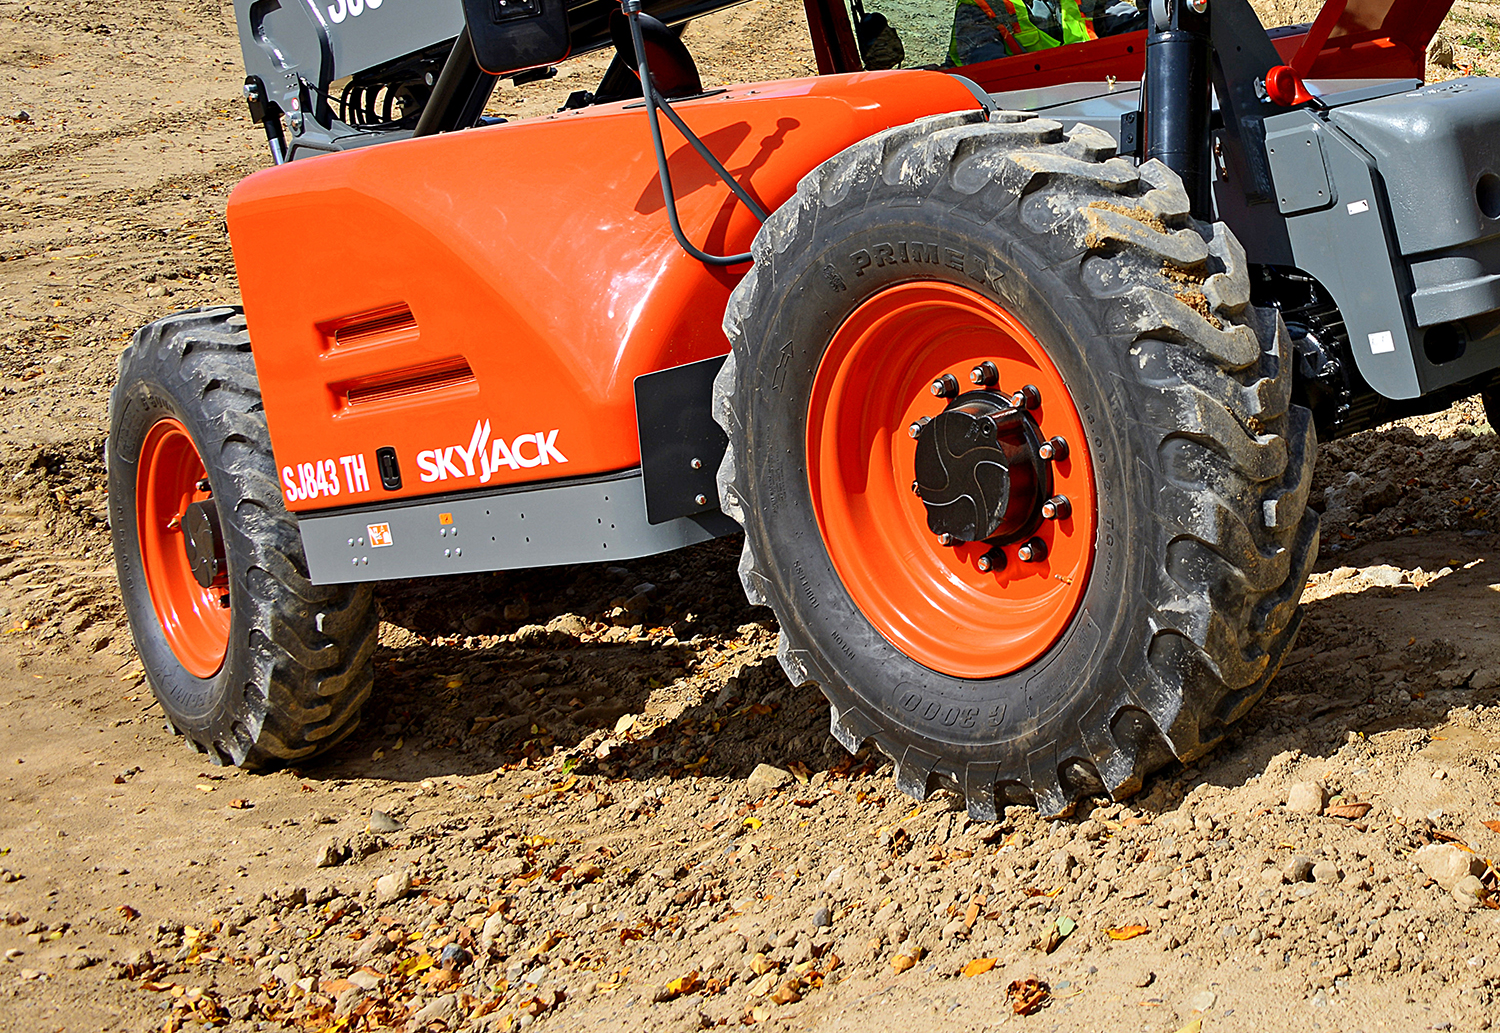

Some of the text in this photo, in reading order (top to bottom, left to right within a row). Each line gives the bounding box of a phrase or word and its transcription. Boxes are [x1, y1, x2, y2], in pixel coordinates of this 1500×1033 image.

[416, 418, 569, 484] SKYJACK
[282, 453, 370, 502] SJ843 TH
[830, 630, 856, 661] NYLON
[899, 691, 980, 729] 3000
